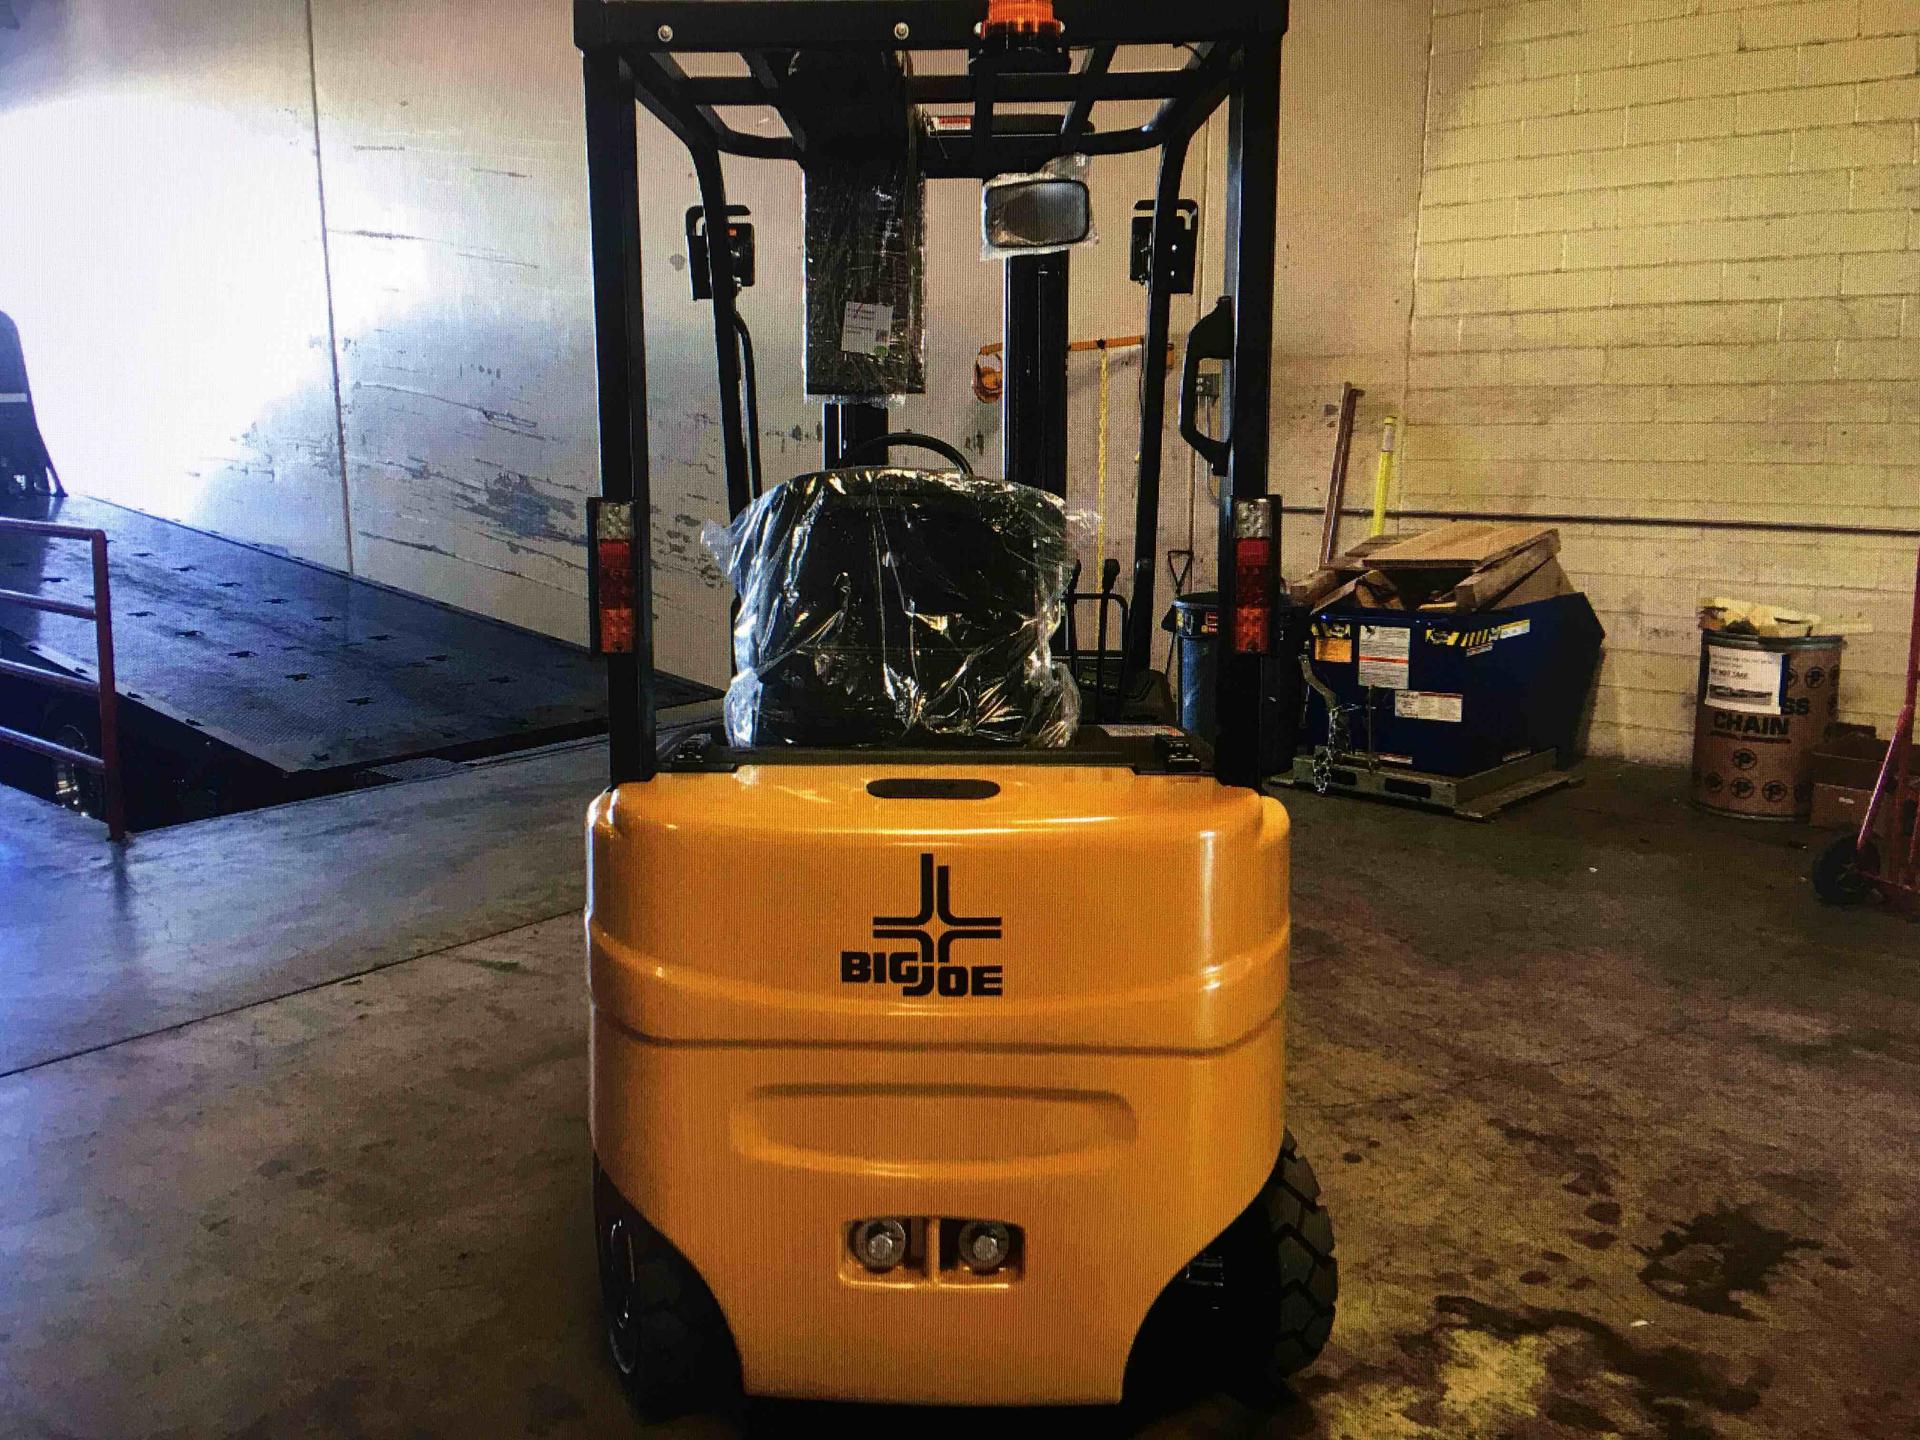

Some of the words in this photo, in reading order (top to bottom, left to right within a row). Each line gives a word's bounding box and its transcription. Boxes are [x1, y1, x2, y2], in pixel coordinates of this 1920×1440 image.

[1714, 711, 1789, 735] CHAIN
[841, 951, 919, 983] BIG
[902, 965, 1003, 996] JOE
